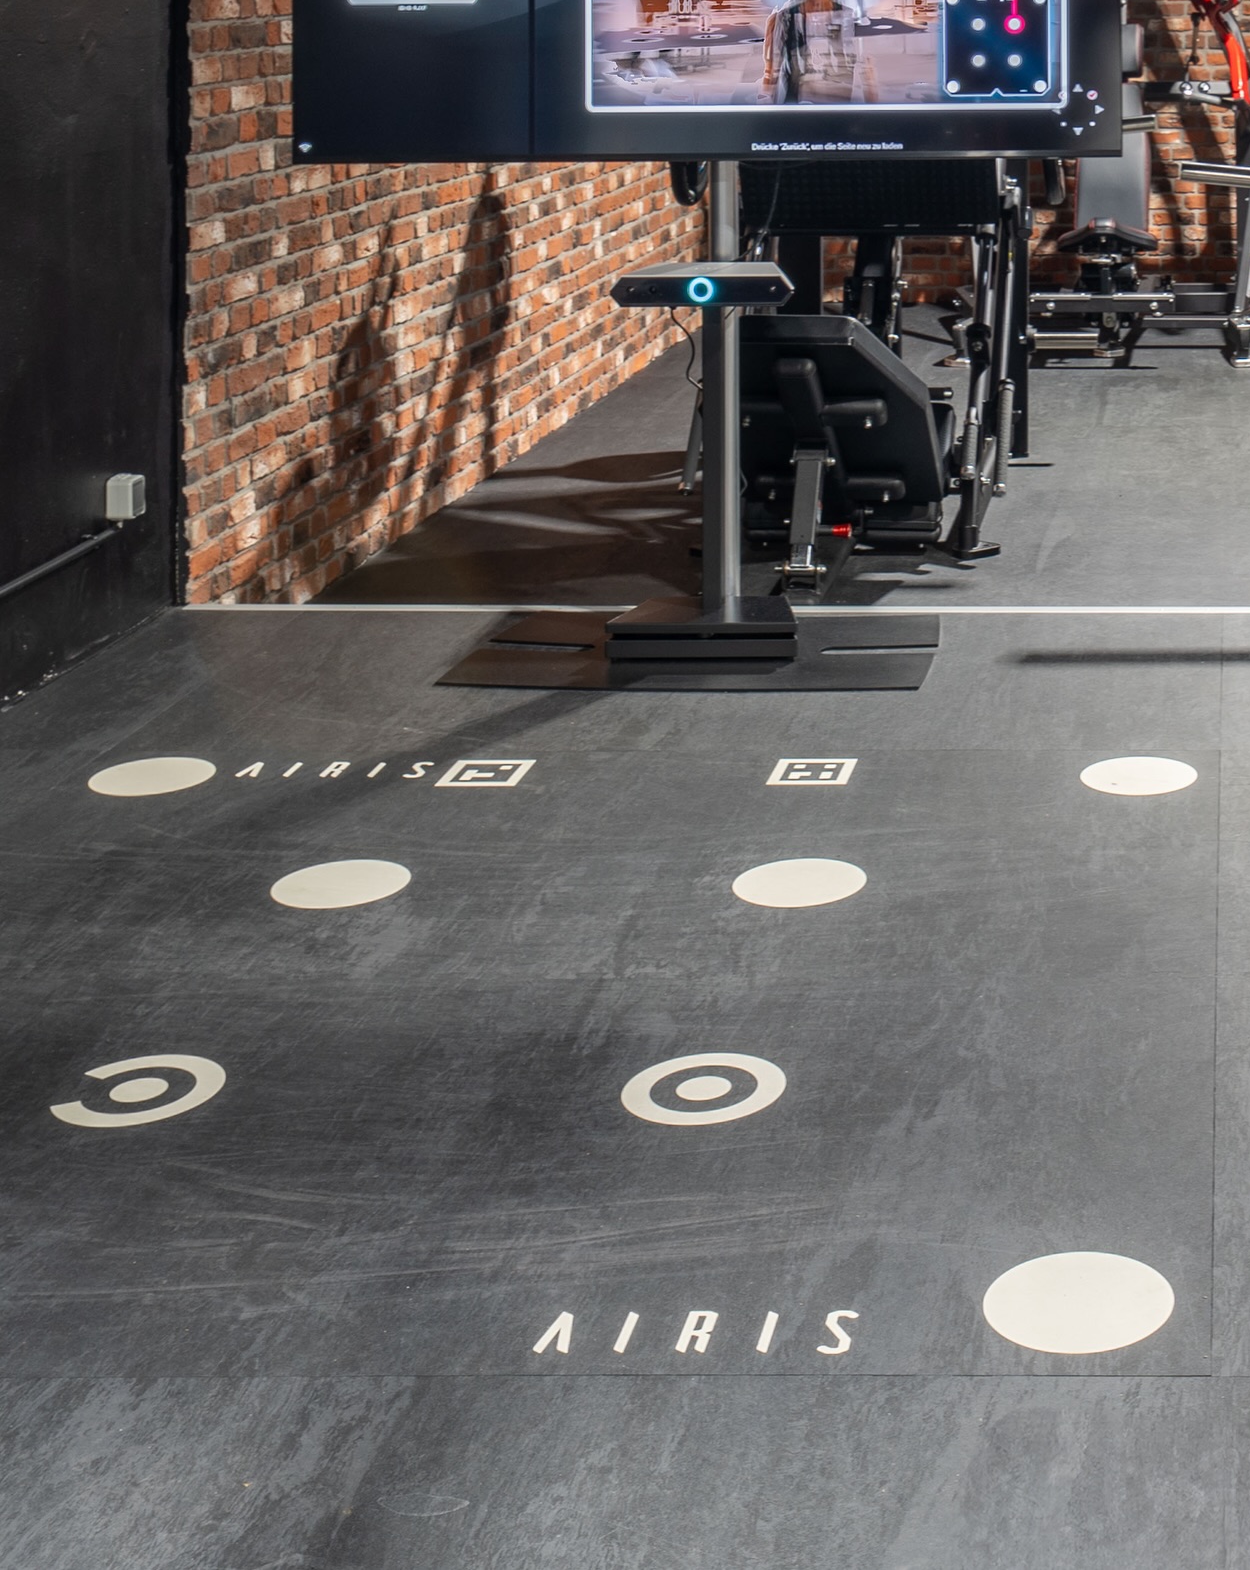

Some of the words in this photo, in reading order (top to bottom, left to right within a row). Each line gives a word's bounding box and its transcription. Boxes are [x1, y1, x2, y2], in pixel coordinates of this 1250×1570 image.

[824, 142, 836, 151] die
[837, 142, 856, 151] Seite
[235, 761, 434, 779] AIRIS
[533, 1310, 859, 1354] AIRIS
